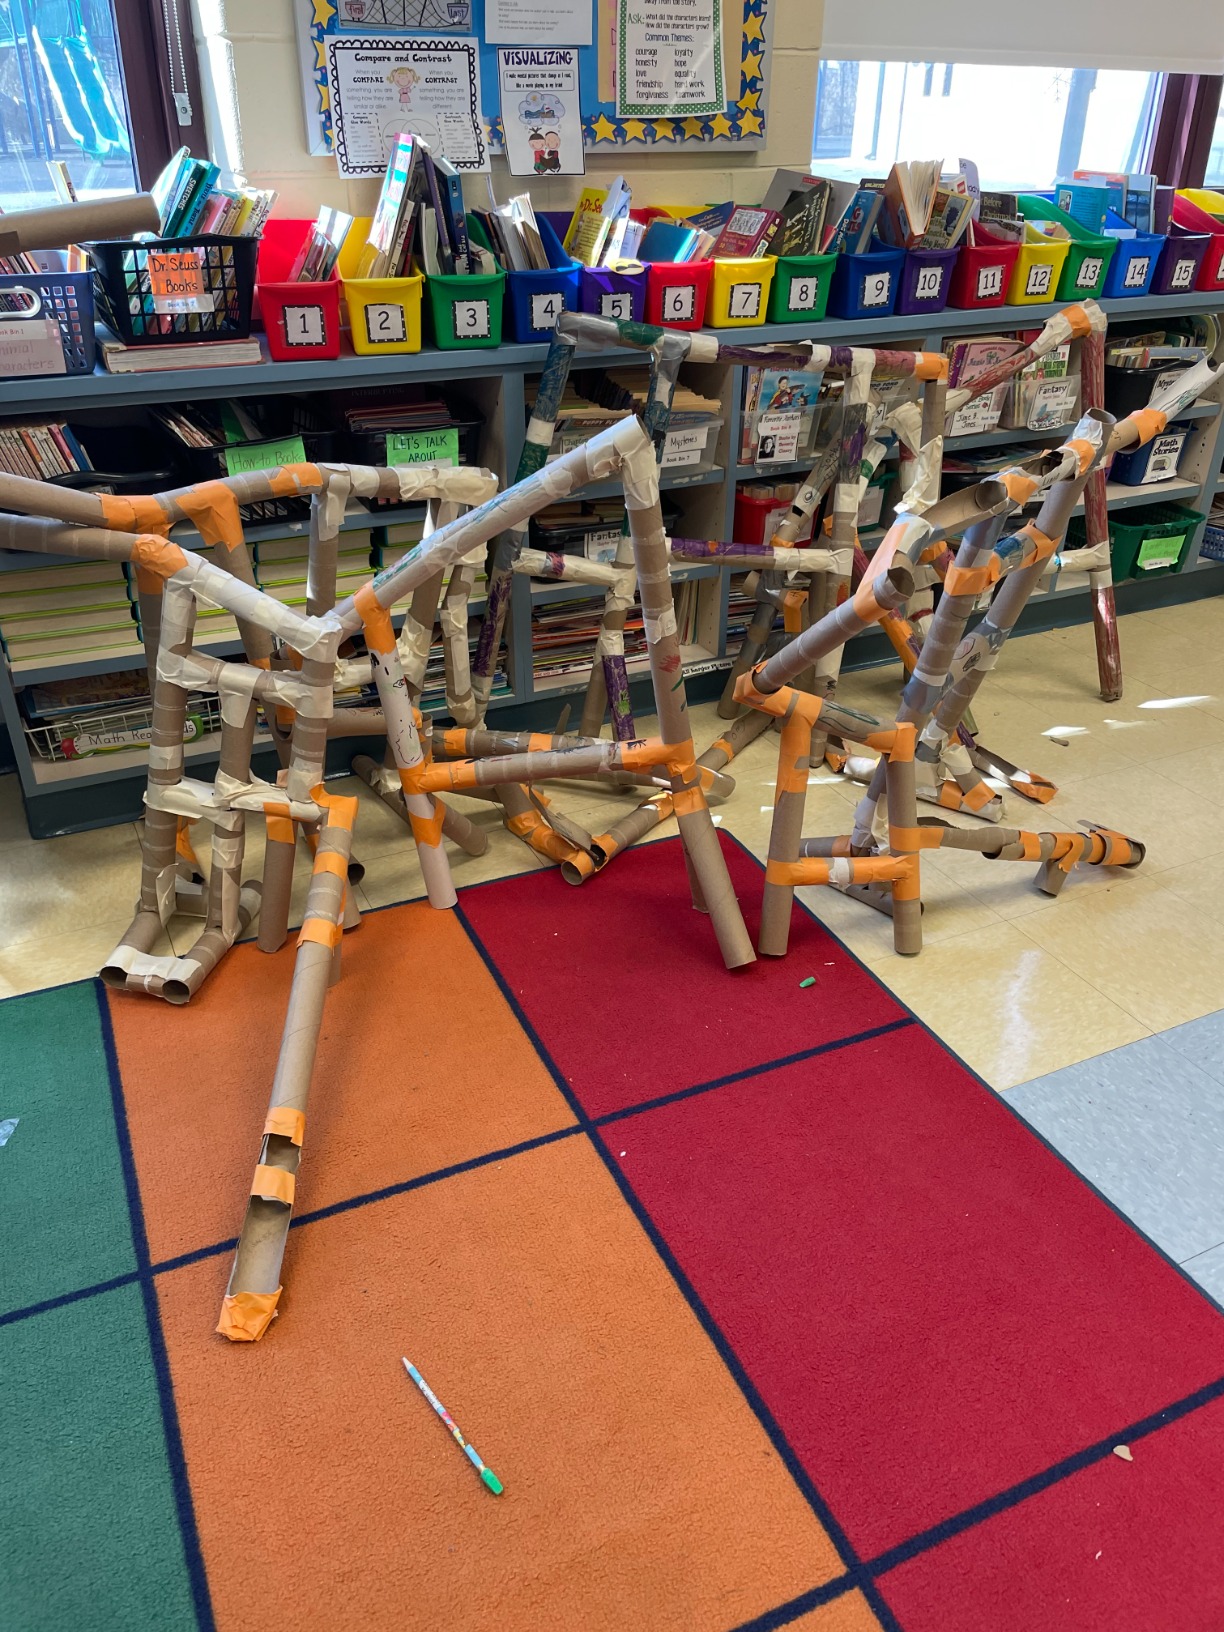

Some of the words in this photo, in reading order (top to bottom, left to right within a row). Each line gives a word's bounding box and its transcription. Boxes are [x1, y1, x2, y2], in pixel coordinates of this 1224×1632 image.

[645, 33, 669, 42] Common
[355, 53, 391, 64] Compare
[394, 54, 409, 62] and
[412, 54, 452, 63] Contrast
[636, 48, 657, 57] courage
[674, 48, 693, 57] loyalty
[636, 58, 657, 67] honesty
[674, 59, 687, 68] hope
[636, 69, 647, 77] love
[674, 70, 696, 78] equality
[636, 80, 663, 89] friendship
[689, 80, 705, 88] work
[636, 90, 668, 100] forgiveness
[676, 90, 705, 98] teamwork
[984, 198, 1002, 207] Before
[152, 258, 168, 273] Dr.
[170, 258, 199, 271] Seuss
[1082, 265, 1098, 280] 13
[1131, 264, 1145, 279] 14
[983, 272, 996, 288] 11
[1033, 270, 1047, 287] 12
[1176, 266, 1190, 281] 15
[166, 280, 198, 293] Books
[875, 280, 884, 297] 9
[920, 274, 937, 290] 10
[799, 285, 808, 301] 8
[673, 293, 683, 311] 6
[742, 292, 752, 309] 7
[543, 300, 555, 318] 4
[612, 300, 622, 318] 5
[300, 314, 309, 333] 1
[378, 311, 391, 330] 2
[466, 308, 477, 327] 3
[1038, 385, 1067, 395] Fantasy
[393, 436, 420, 450] LET'S
[425, 435, 448, 448] TALK
[670, 436, 698, 450] Mysteries
[1160, 439, 1178, 447] Math
[408, 450, 437, 463] ABOUT
[1153, 446, 1179, 456] Stories
[231, 452, 271, 470] How-to
[275, 451, 304, 465] Books
[711, 662, 731, 670] Picture
[89, 731, 125, 745] Math
